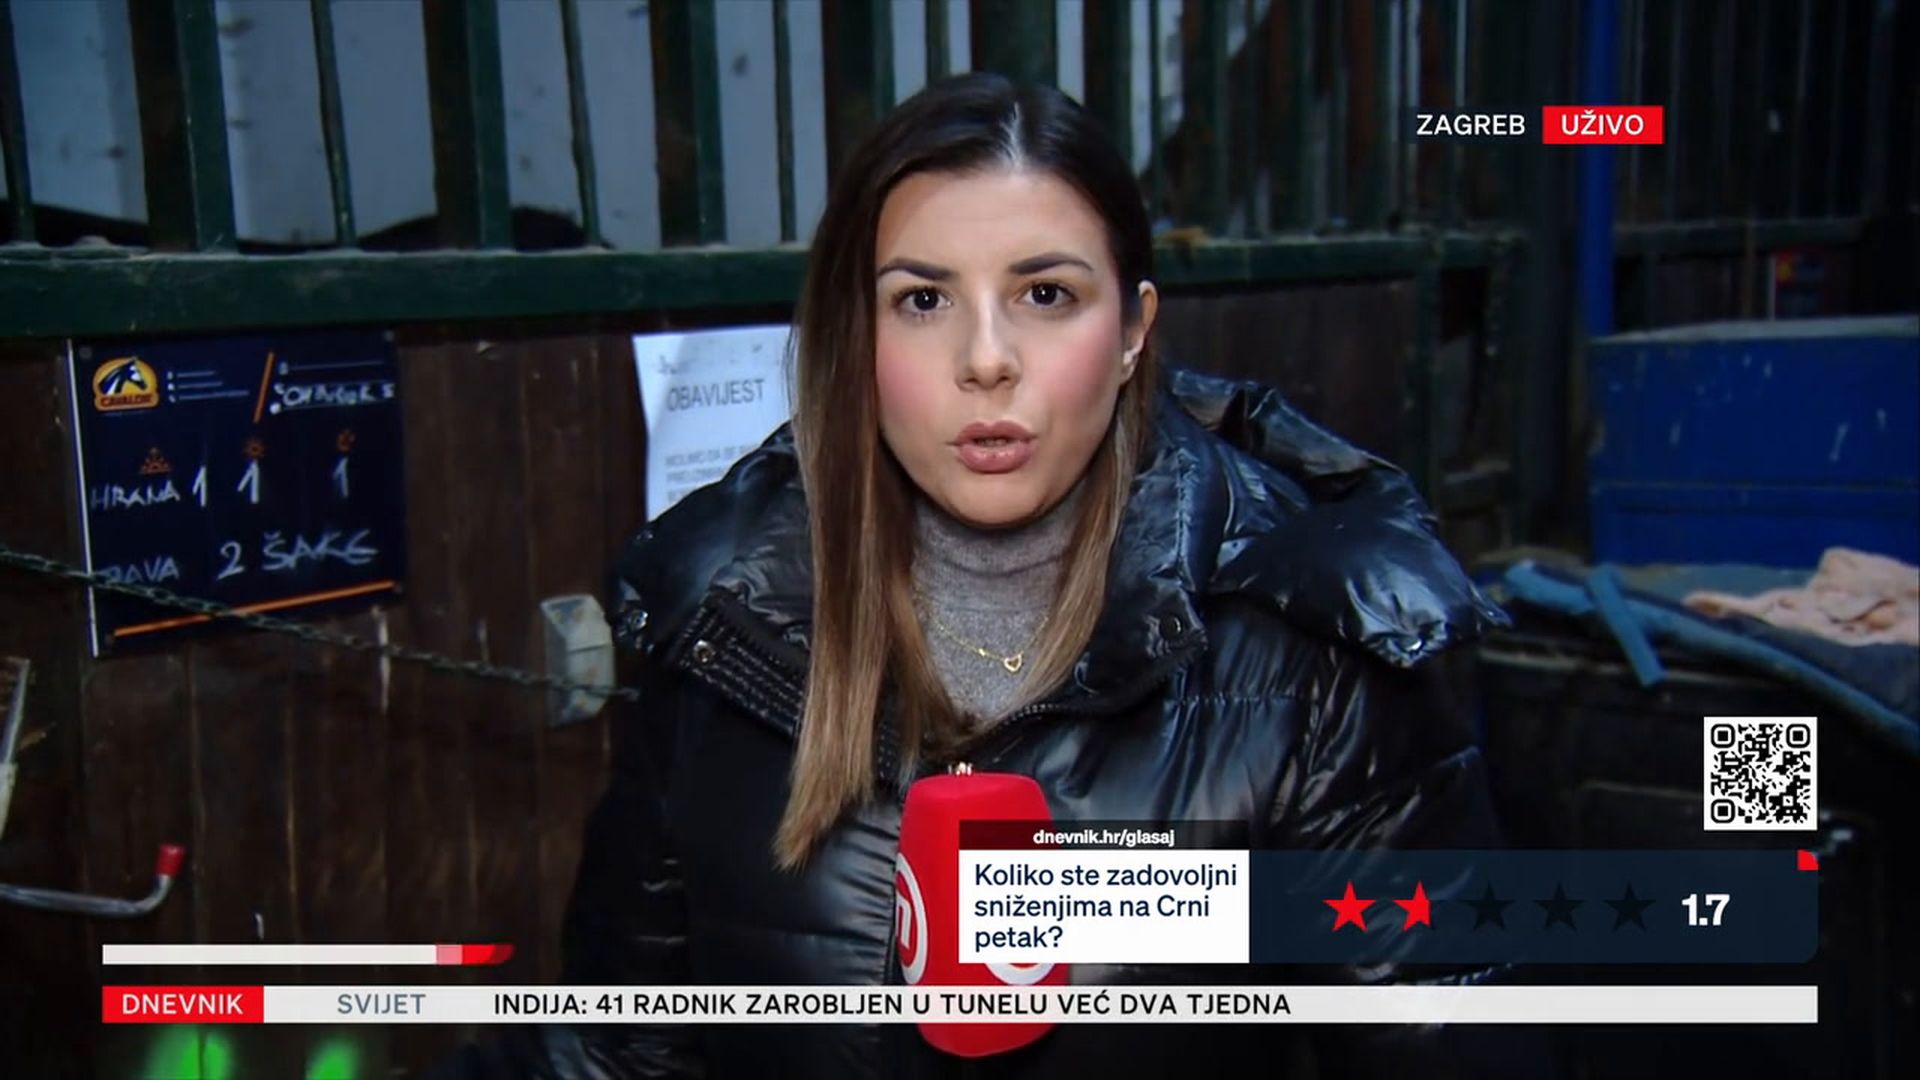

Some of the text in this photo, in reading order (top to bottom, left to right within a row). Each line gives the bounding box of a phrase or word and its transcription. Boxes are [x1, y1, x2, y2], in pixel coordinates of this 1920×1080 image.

[665, 378, 765, 412] OBAVIJEST
[236, 459, 260, 504] 1
[216, 541, 245, 580] 2
